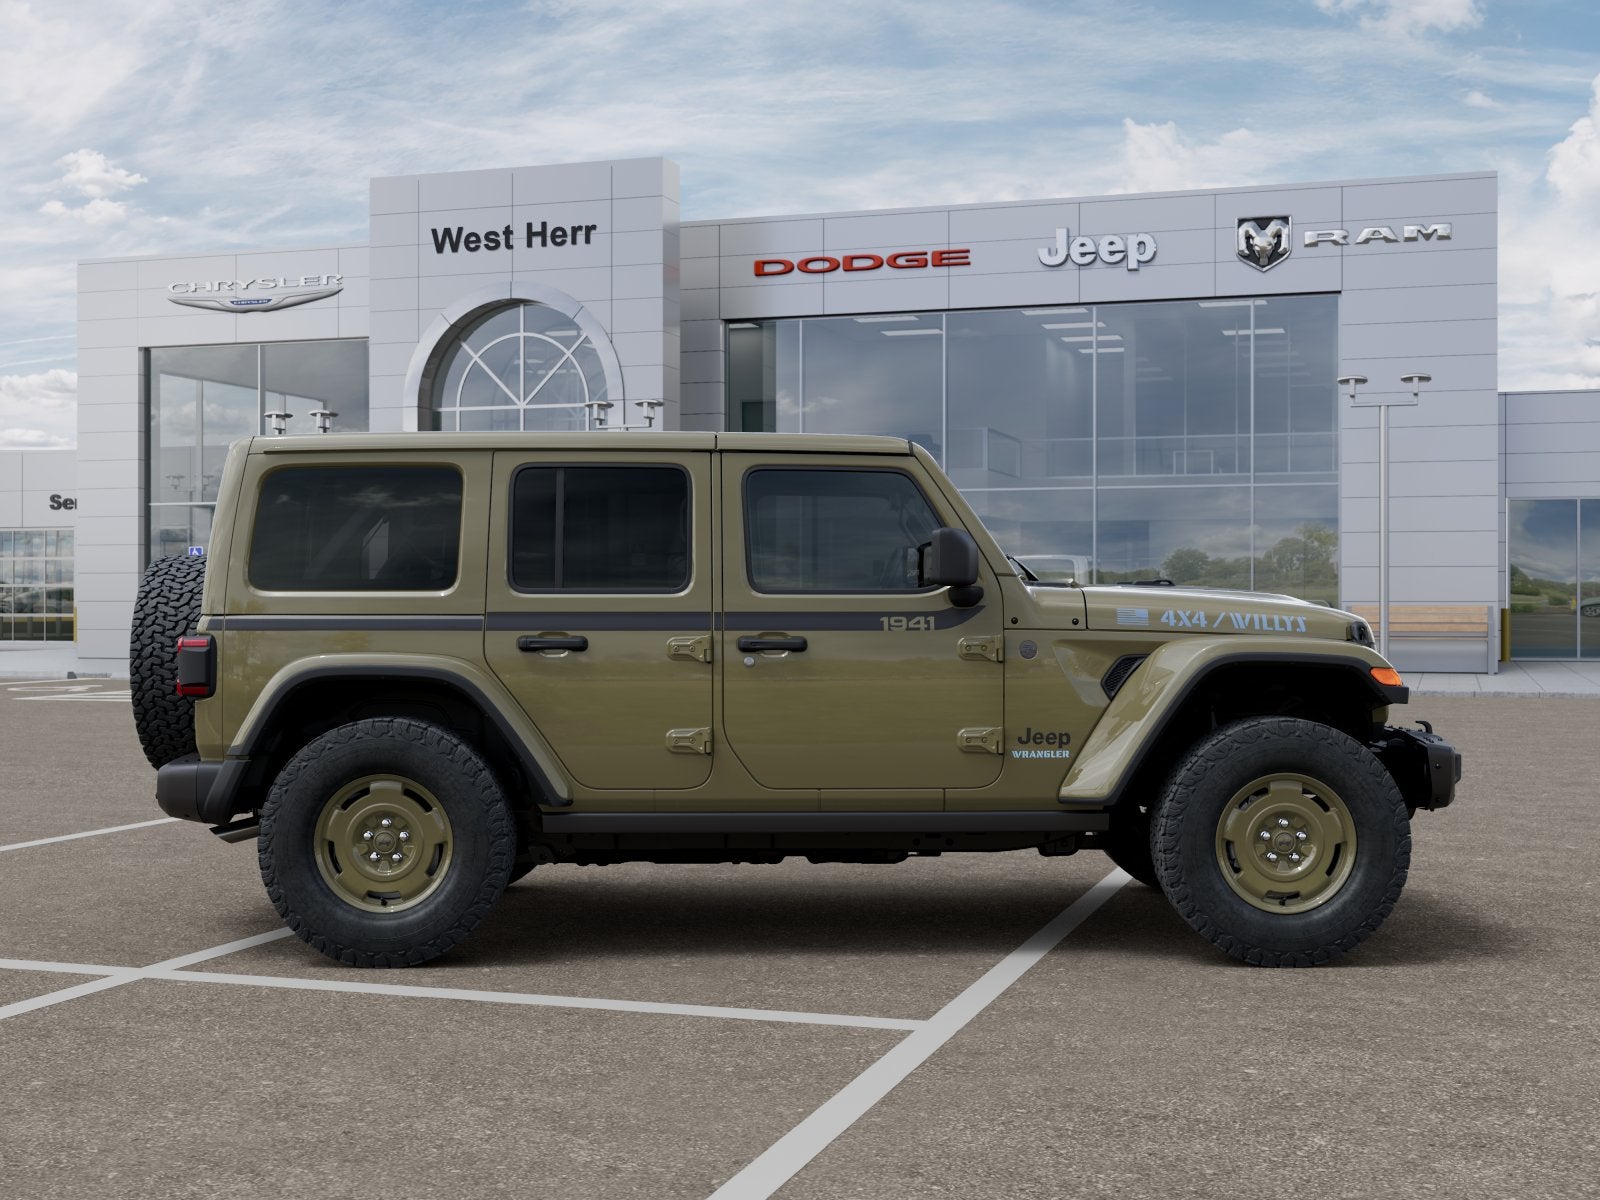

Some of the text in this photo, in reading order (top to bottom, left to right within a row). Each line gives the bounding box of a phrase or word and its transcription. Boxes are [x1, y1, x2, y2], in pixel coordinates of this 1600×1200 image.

[431, 221, 597, 254] West Herr
[1304, 223, 1452, 247] RAM
[1038, 227, 1156, 271] Jeep
[754, 248, 971, 276] DODGE
[168, 273, 343, 293] CHRYSLER
[49, 494, 77, 510] Se
[880, 616, 935, 632] 1941
[1160, 609, 1207, 628] 4X4
[1230, 611, 1307, 632] WILLYS
[1017, 728, 1071, 748] Jeep
[1011, 750, 1070, 759] WRANGLER
